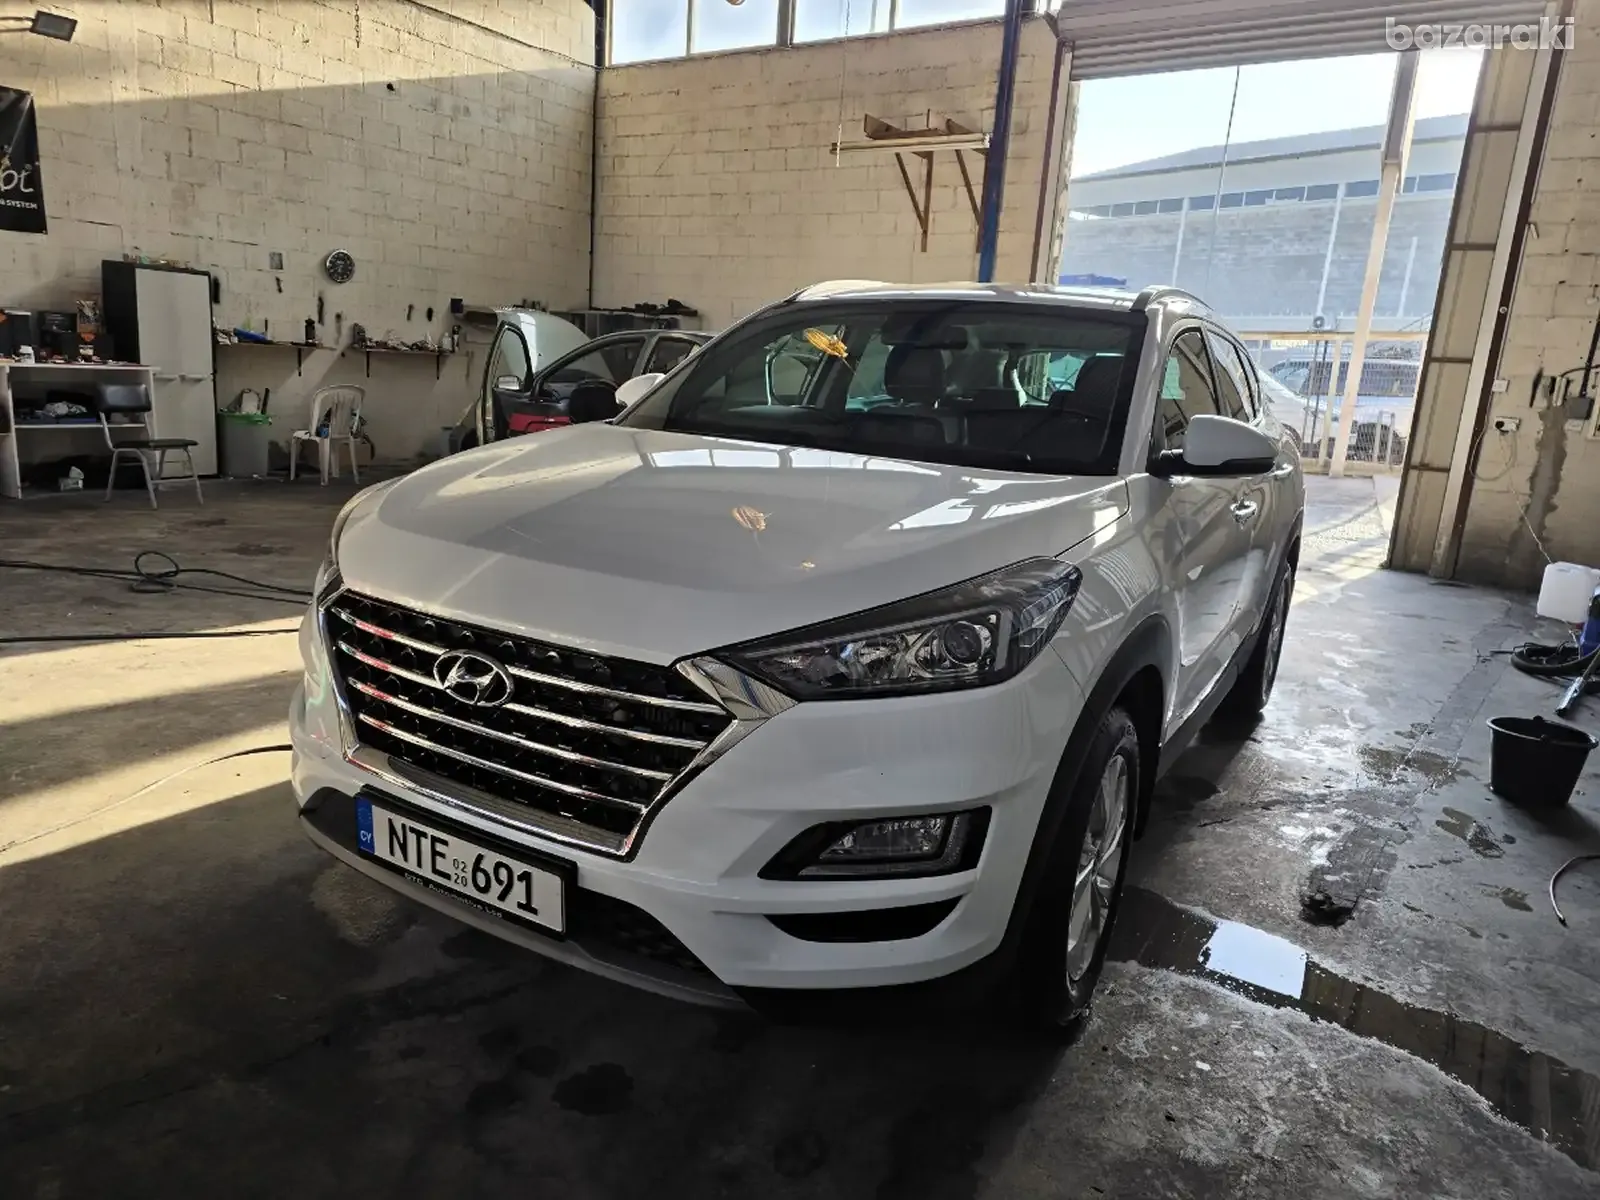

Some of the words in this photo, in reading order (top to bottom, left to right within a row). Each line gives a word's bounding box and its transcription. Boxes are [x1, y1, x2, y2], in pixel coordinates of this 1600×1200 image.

[6, 199, 38, 210] SYSTEM
[360, 830, 372, 844] CY
[387, 817, 452, 881] NTE
[471, 852, 538, 915] 691
[452, 858, 468, 873] 02
[453, 873, 468, 888] 20
